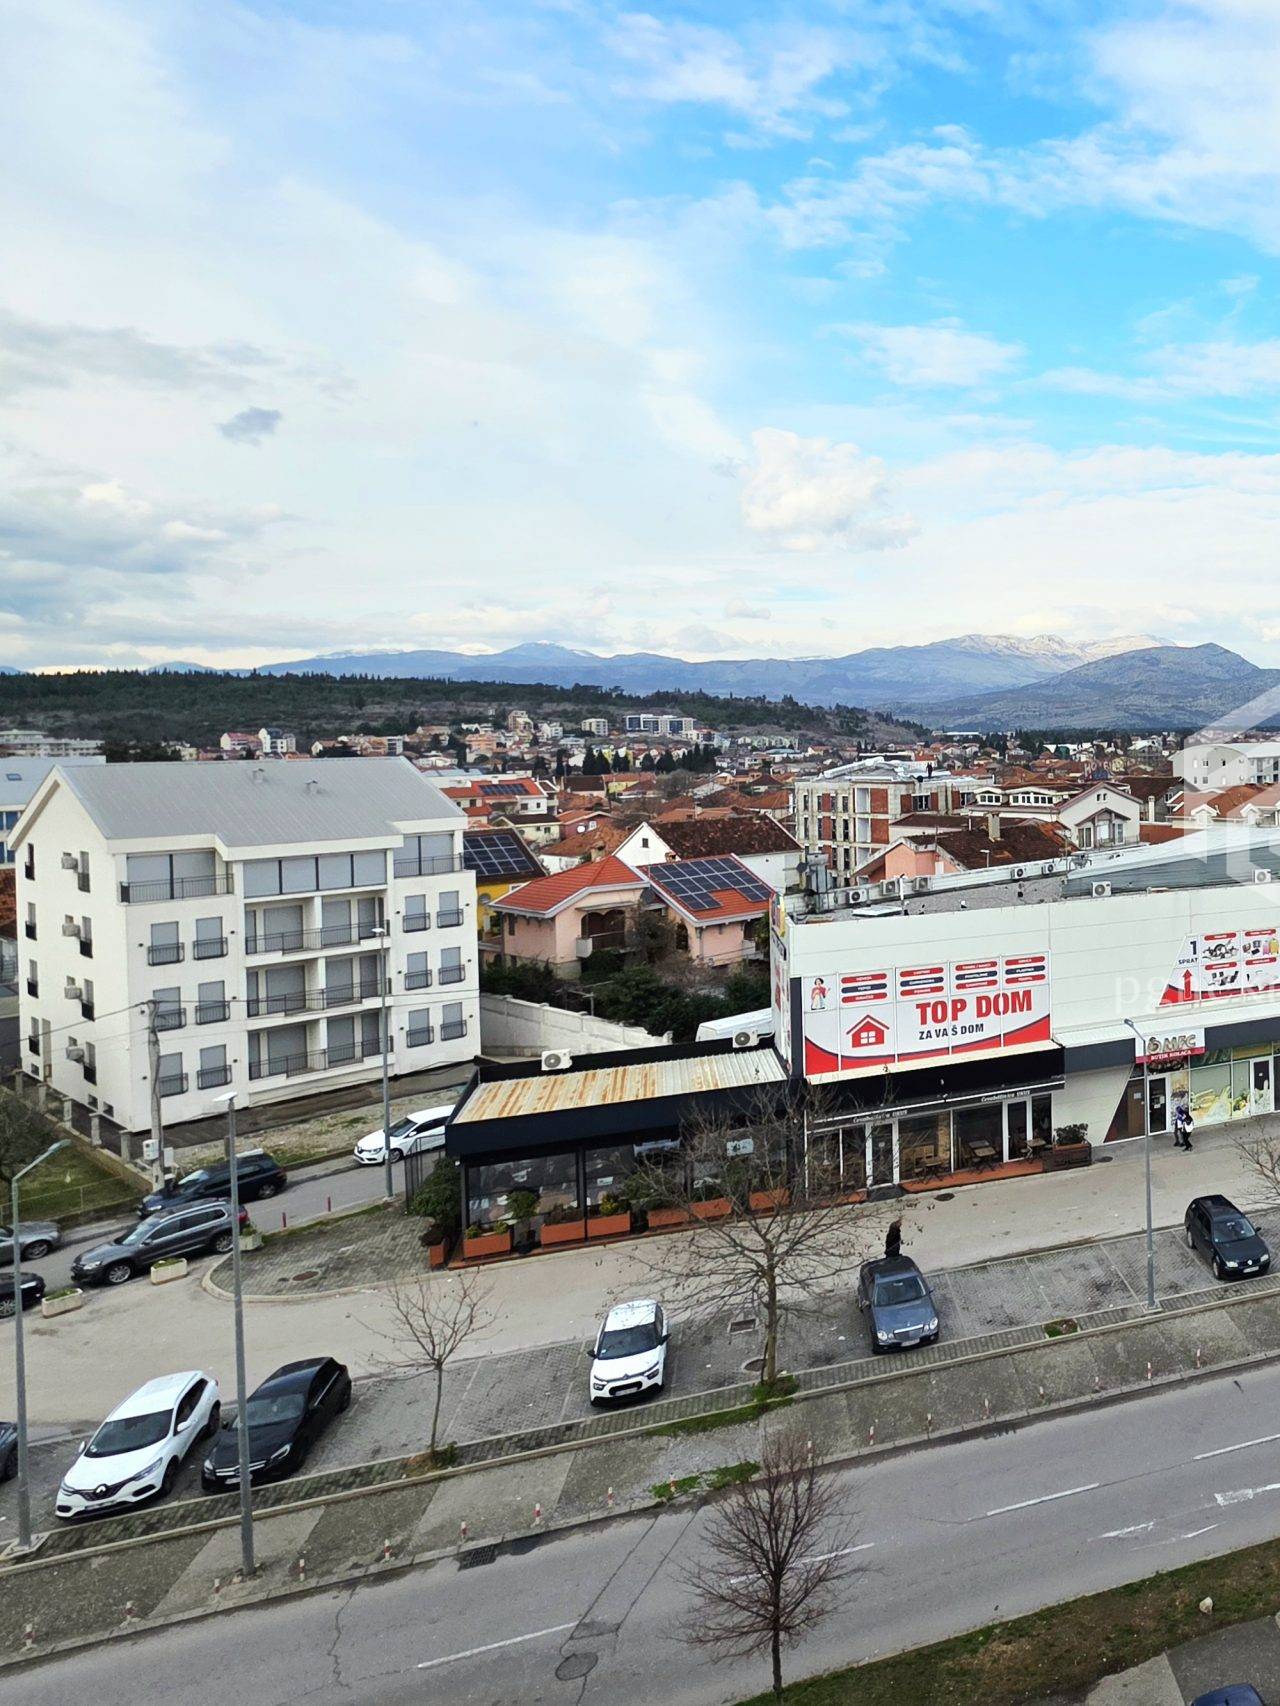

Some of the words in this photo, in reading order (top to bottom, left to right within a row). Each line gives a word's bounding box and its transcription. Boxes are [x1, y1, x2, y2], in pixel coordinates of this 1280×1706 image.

[1190, 940, 1197, 955] 1
[1178, 957, 1198, 965] SPRAT
[916, 998, 967, 1026] TOP
[976, 989, 1032, 1018] DOM
[919, 1030, 932, 1040] ZA
[935, 1024, 958, 1038] VAŠ
[961, 1023, 984, 1035] DOM
[1150, 1053, 1168, 1061] BUTIK
